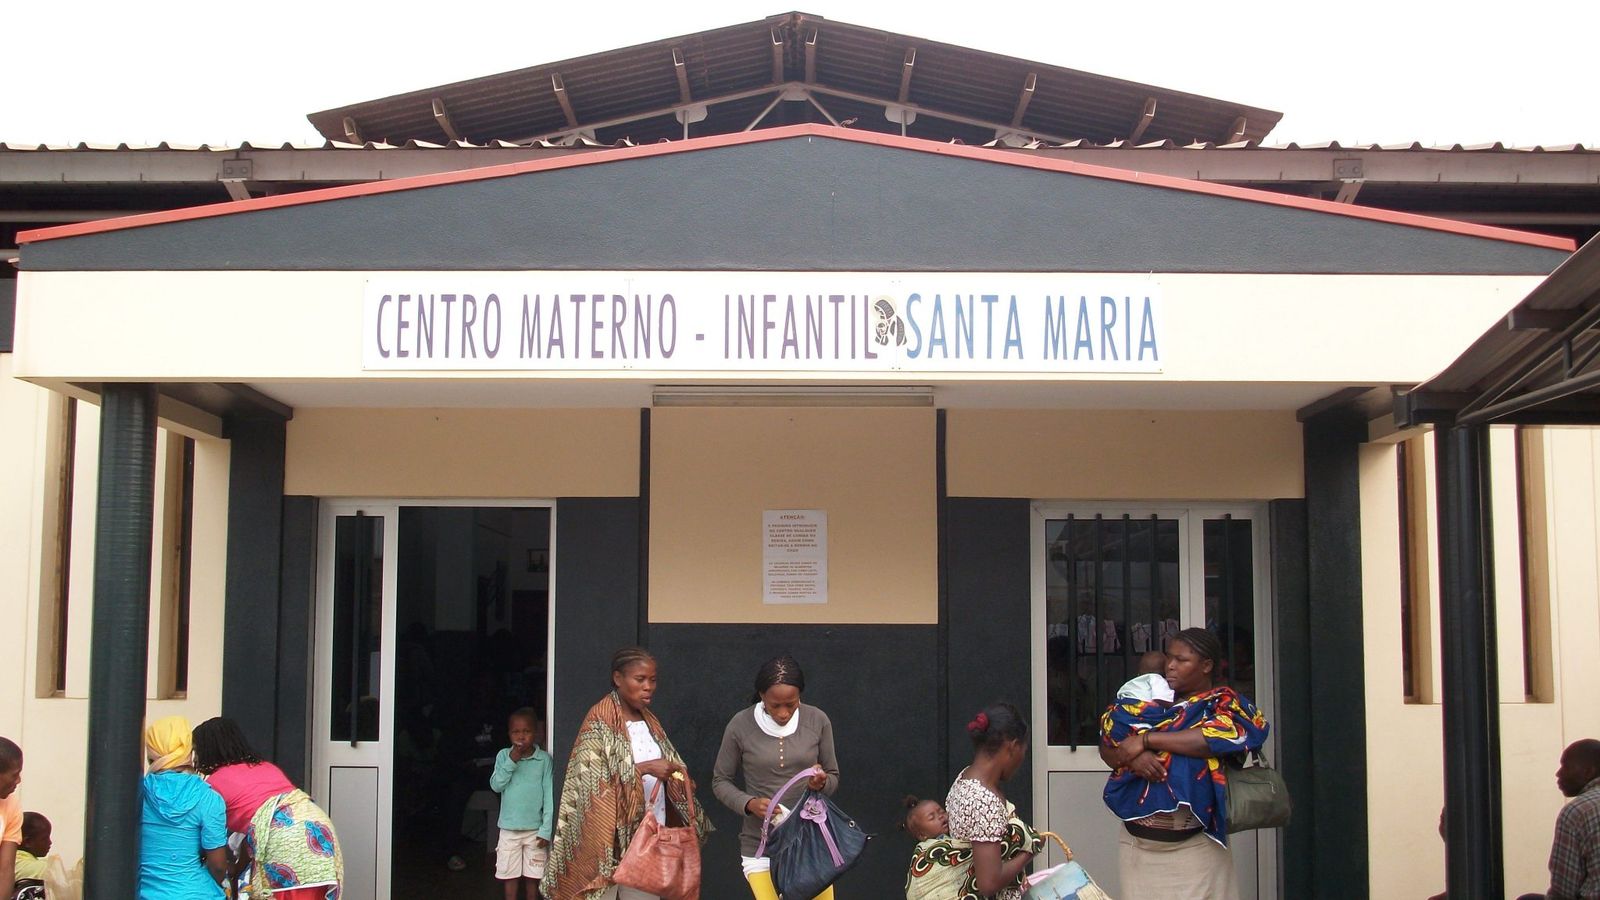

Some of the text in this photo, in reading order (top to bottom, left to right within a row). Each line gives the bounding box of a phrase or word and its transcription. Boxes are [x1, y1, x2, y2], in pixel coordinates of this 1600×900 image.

[376, 293, 502, 359] CENTRO
[519, 293, 677, 359] MATERNO
[724, 294, 878, 360] INFANTIL
[906, 292, 1024, 360] SANTA
[1043, 295, 1159, 361] MARIA
